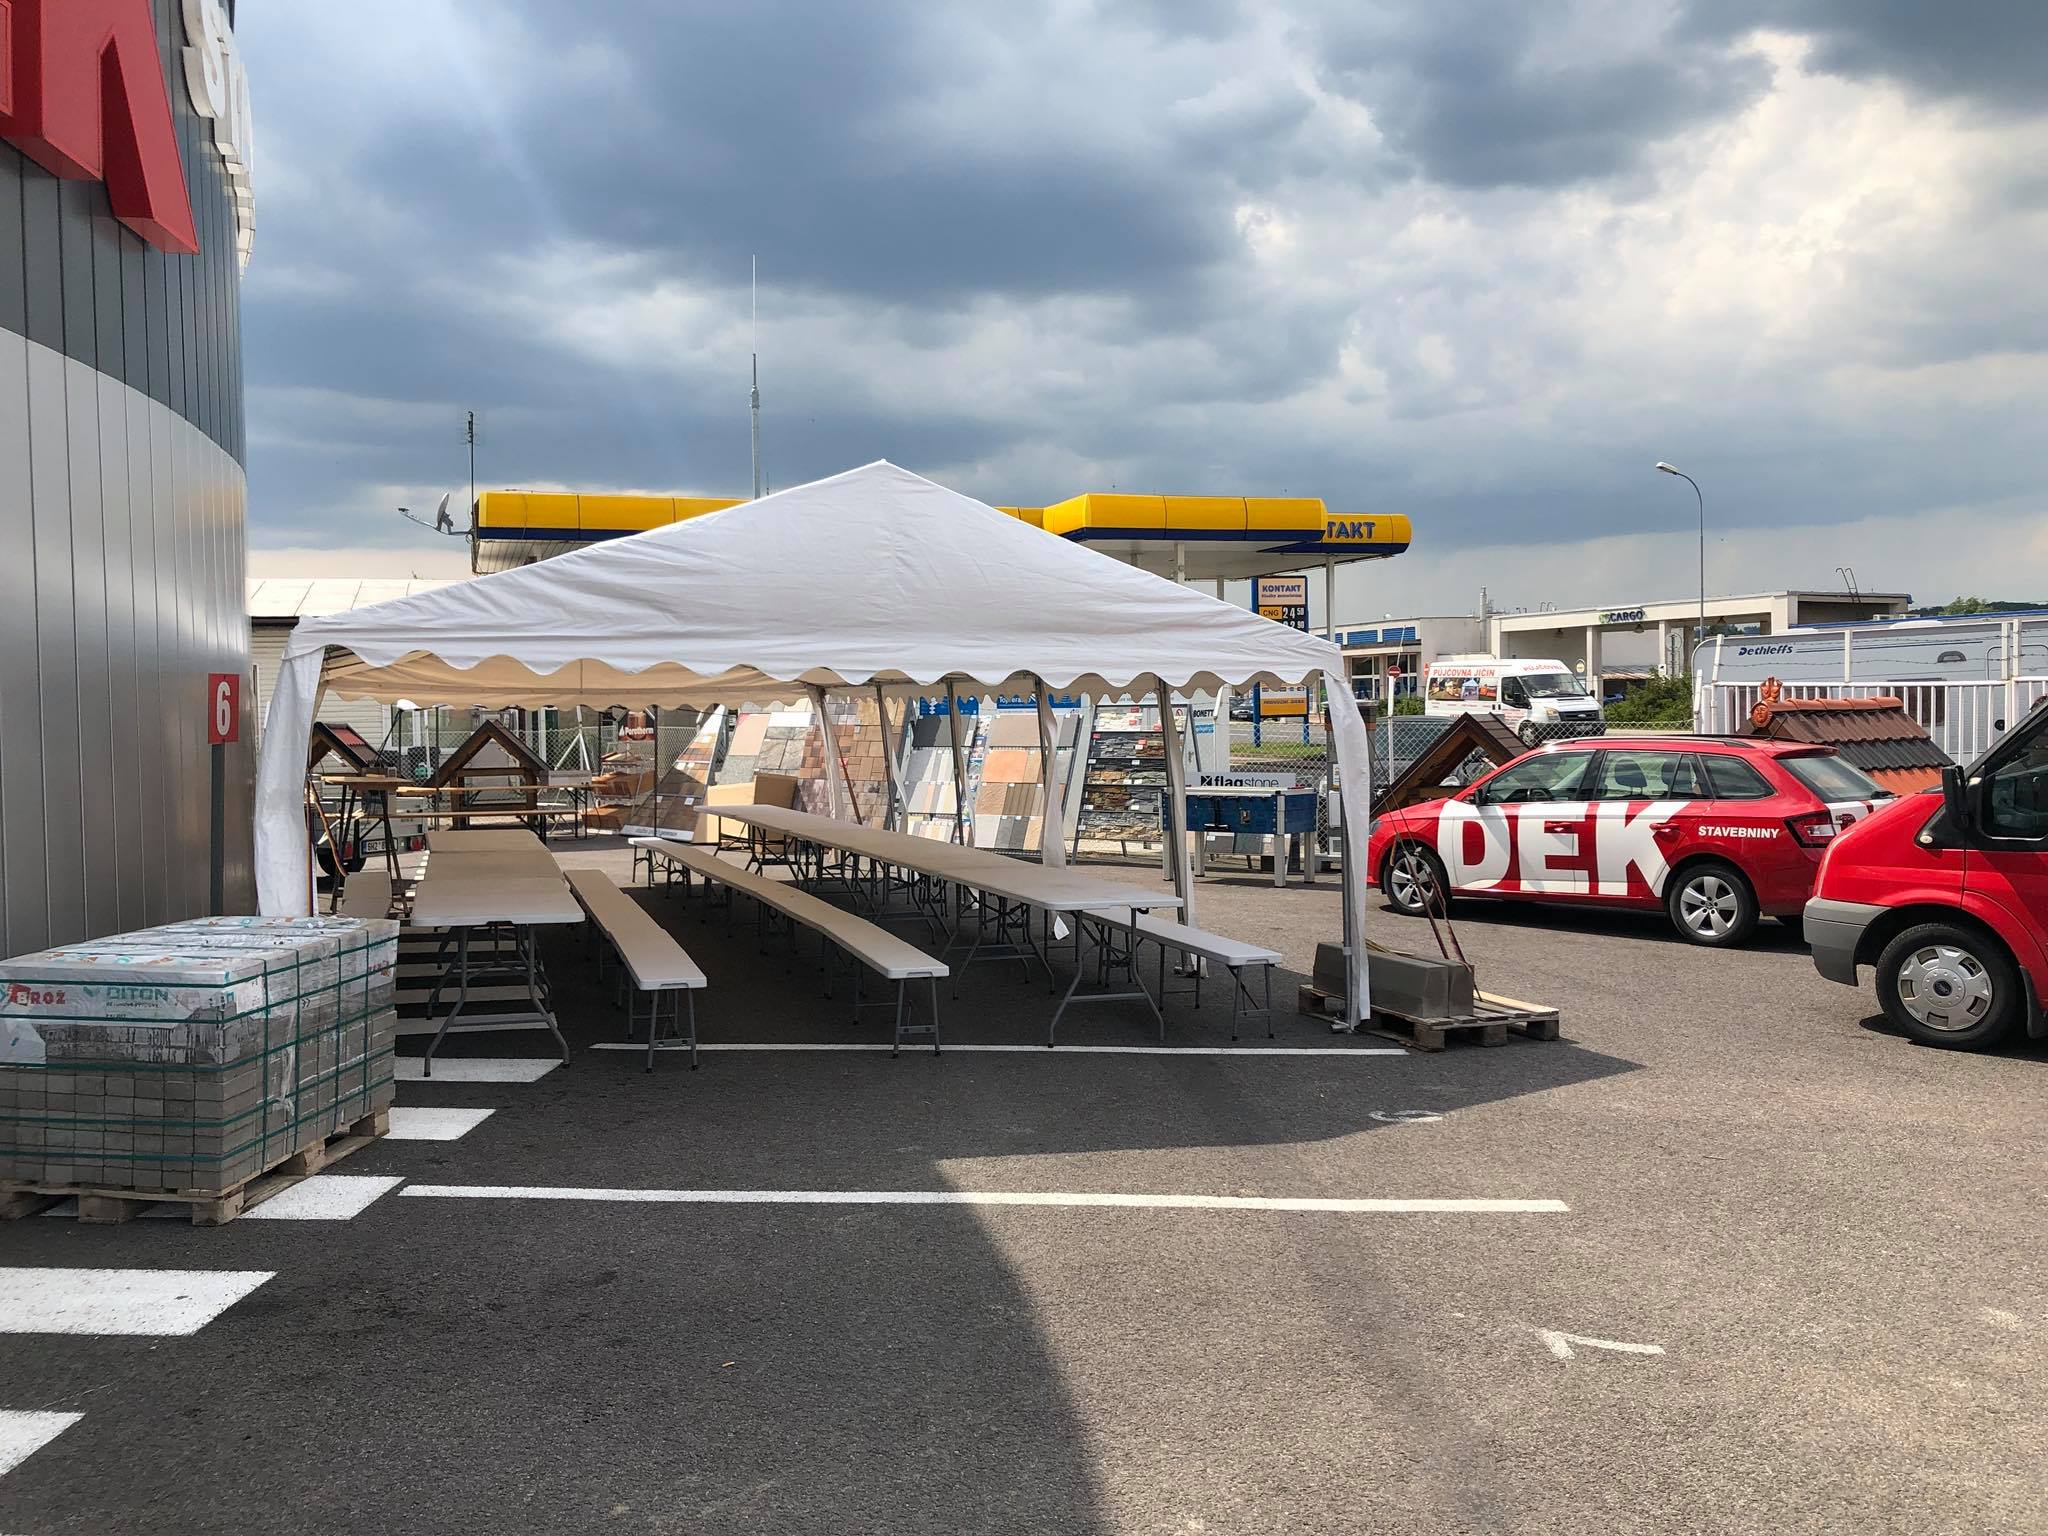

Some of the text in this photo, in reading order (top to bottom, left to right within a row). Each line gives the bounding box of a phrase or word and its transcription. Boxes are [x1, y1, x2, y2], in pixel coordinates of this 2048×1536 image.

[1262, 584, 1301, 592] KONTAKT
[1738, 645, 1793, 656] Dethleffs
[216, 681, 231, 736] 6
[1214, 775, 1279, 788] flagstone
[1698, 825, 1780, 839] STAVEBNINY
[1438, 799, 1692, 898] DEK
